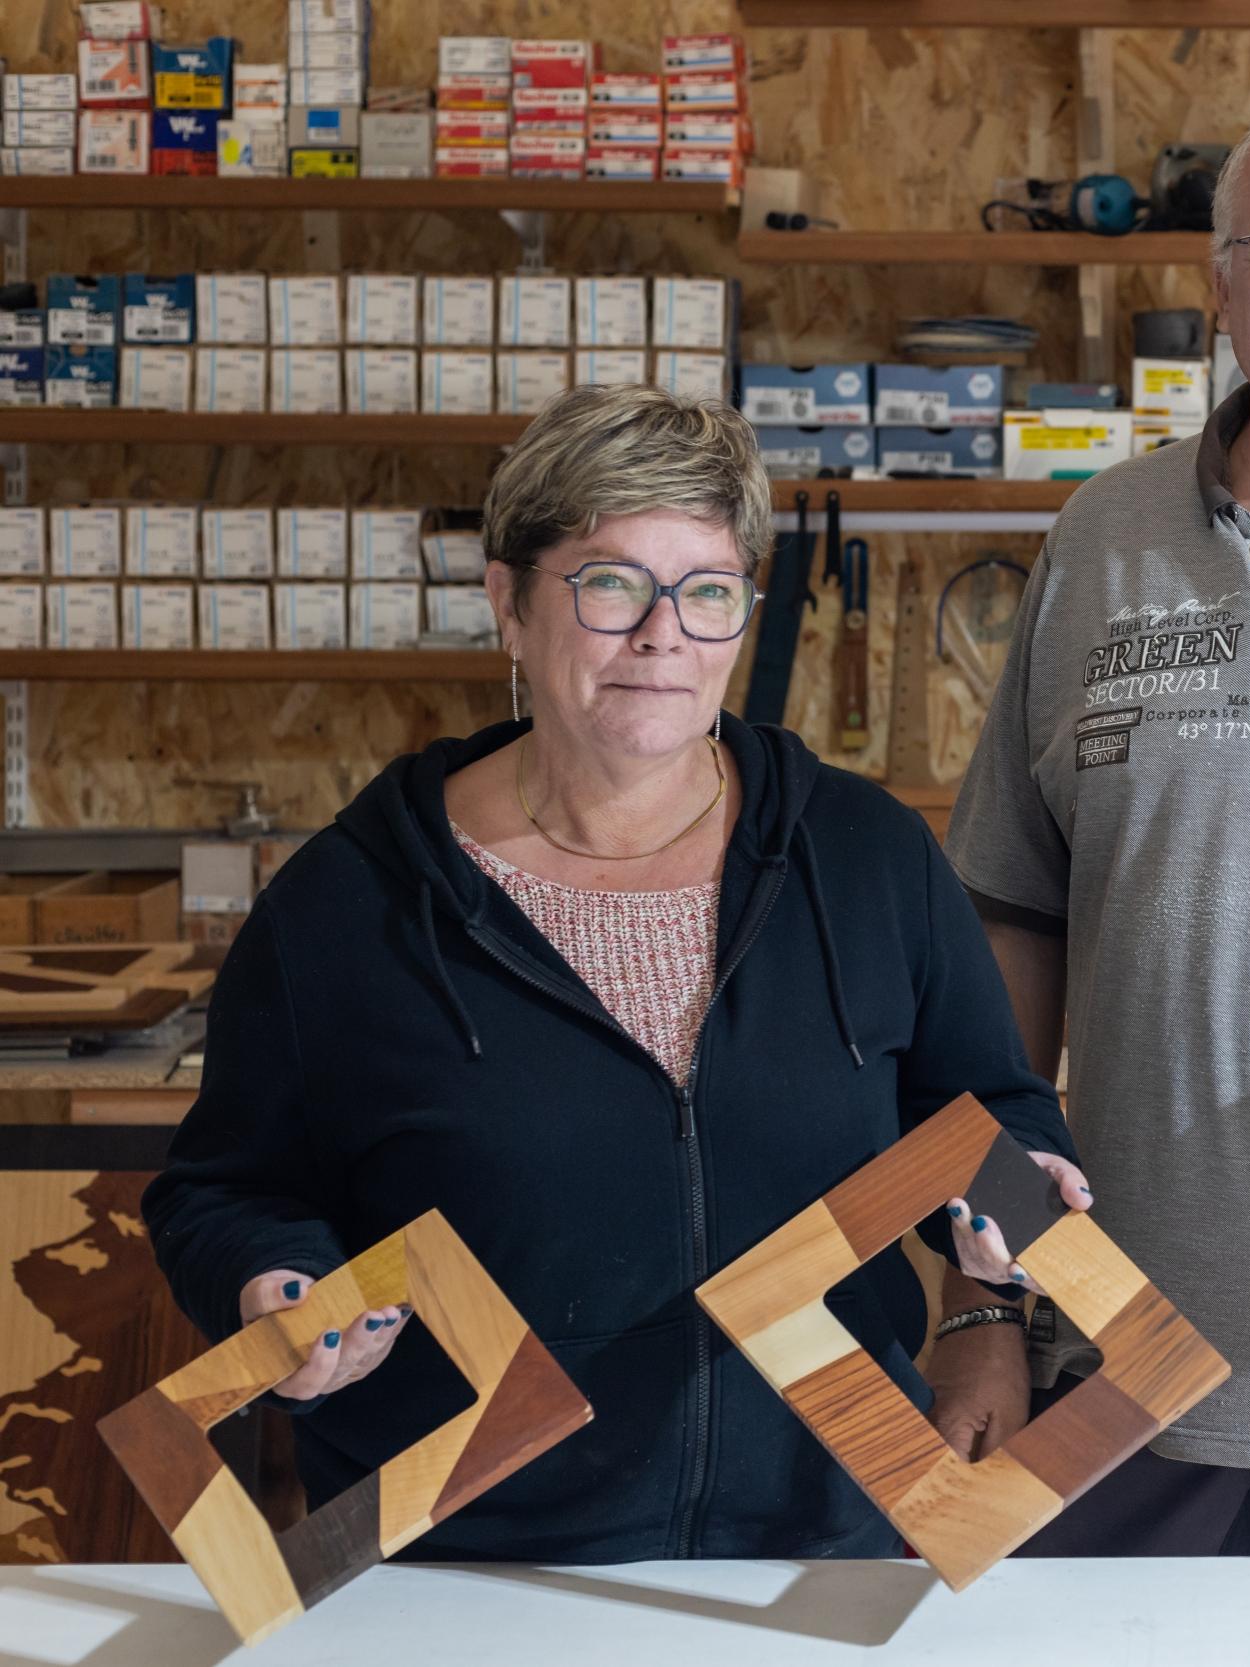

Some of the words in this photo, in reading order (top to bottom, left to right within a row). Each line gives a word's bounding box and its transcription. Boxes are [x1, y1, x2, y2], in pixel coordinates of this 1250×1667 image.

[1110, 621, 1142, 638] High
[1146, 613, 1190, 631] Level
[1194, 610, 1235, 627] Corp.
[1084, 622, 1243, 686] GREEN
[1085, 667, 1221, 708] SECTOR//31
[1146, 707, 1240, 722] Corporate
[1080, 733, 1127, 752] MEETING
[1084, 750, 1118, 766] POINT
